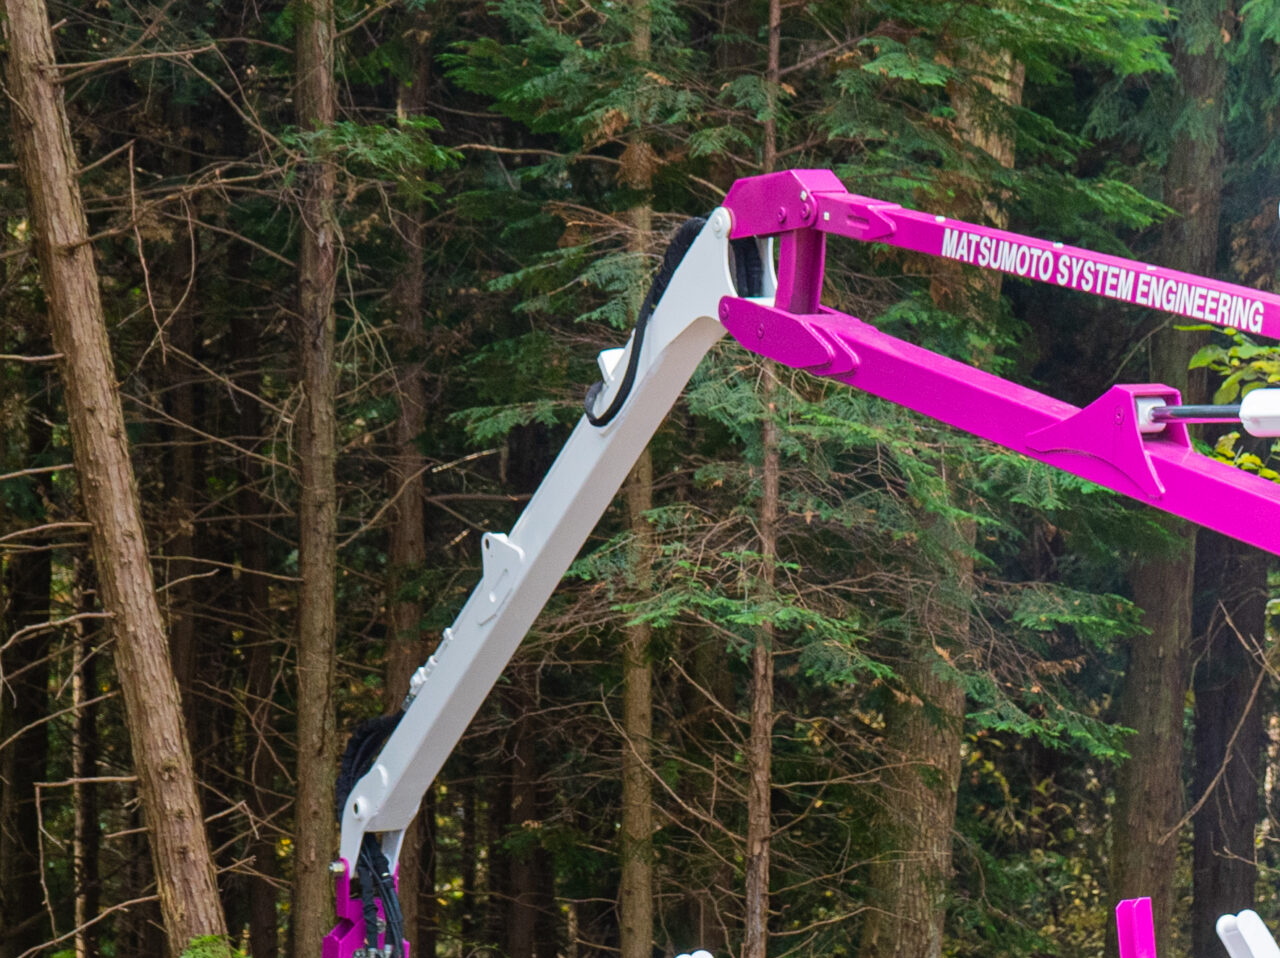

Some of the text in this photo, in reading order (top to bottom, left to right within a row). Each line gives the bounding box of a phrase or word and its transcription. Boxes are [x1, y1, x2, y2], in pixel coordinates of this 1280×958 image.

[941, 228, 1265, 334] MATSUMOTO SYSTEM ENGINEERING
